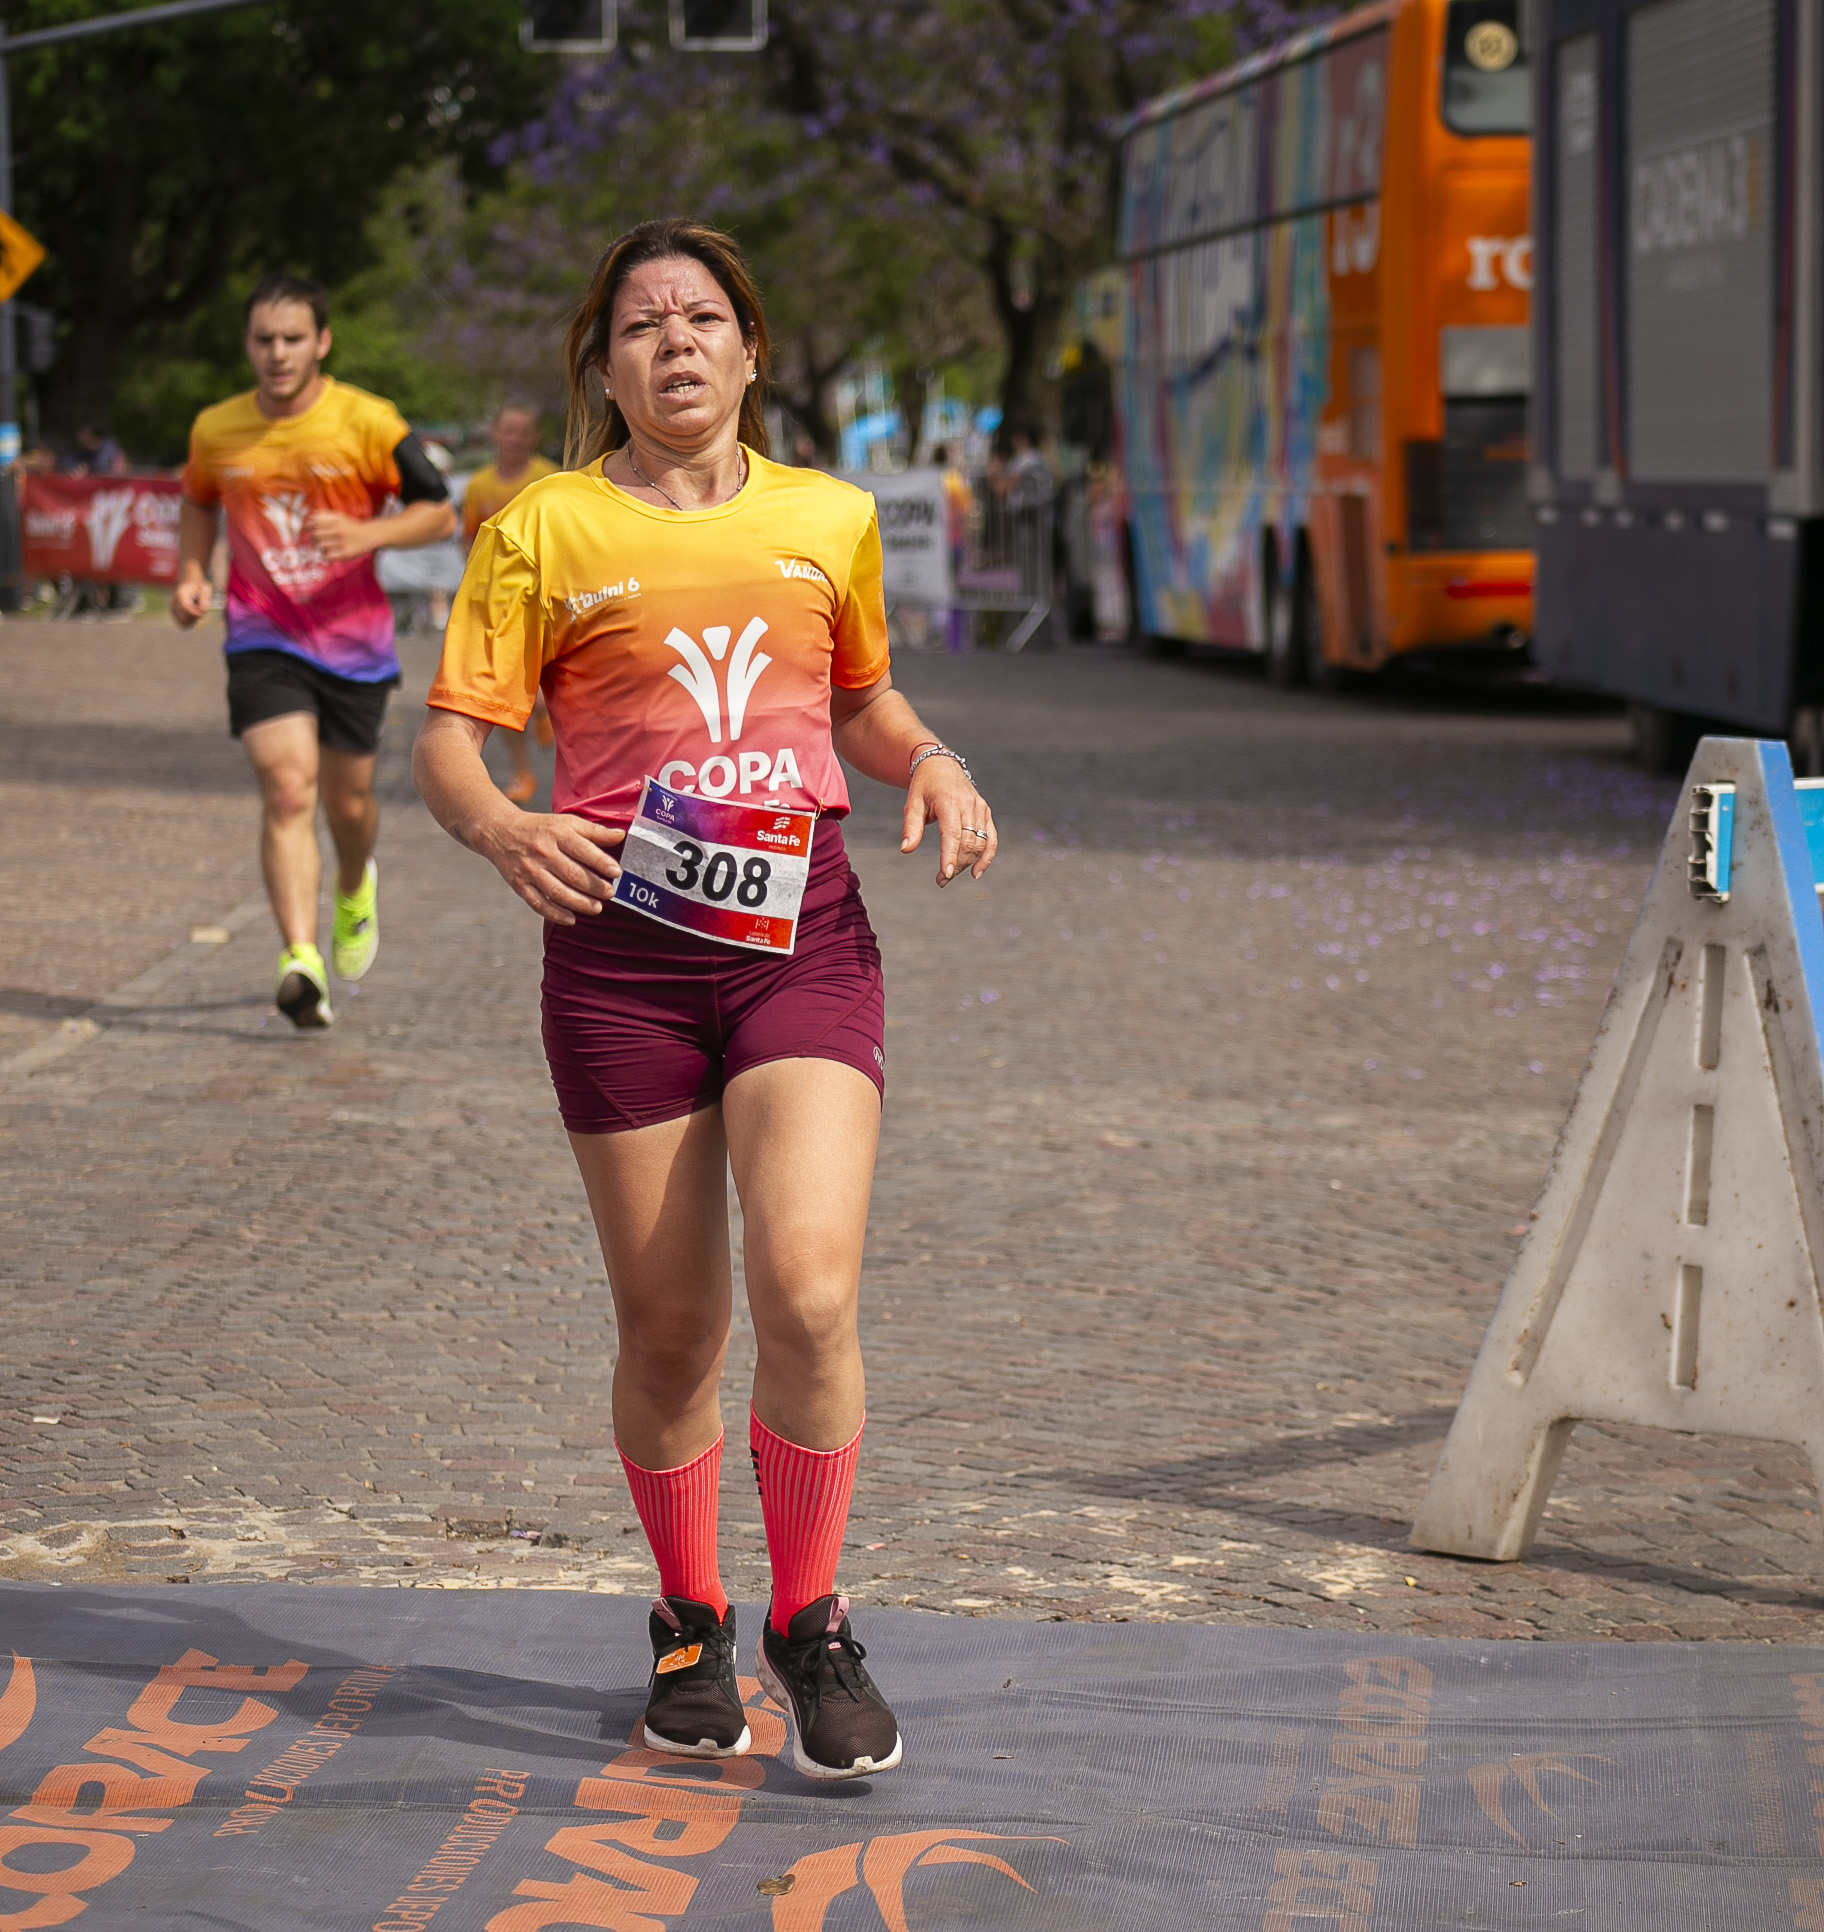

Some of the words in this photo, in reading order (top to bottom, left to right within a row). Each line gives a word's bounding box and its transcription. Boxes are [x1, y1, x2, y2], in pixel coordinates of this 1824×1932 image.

[627, 576, 640, 592] 6
[658, 748, 803, 798] COPA
[655, 808, 675, 822] COPA
[757, 830, 788, 845] Santa
[789, 835, 801, 847] Fe
[665, 840, 771, 908] 308
[629, 882, 660, 910] 10k
[746, 935, 763, 944] Santa
[406, 1767, 532, 1893] PRODUCCIONES
